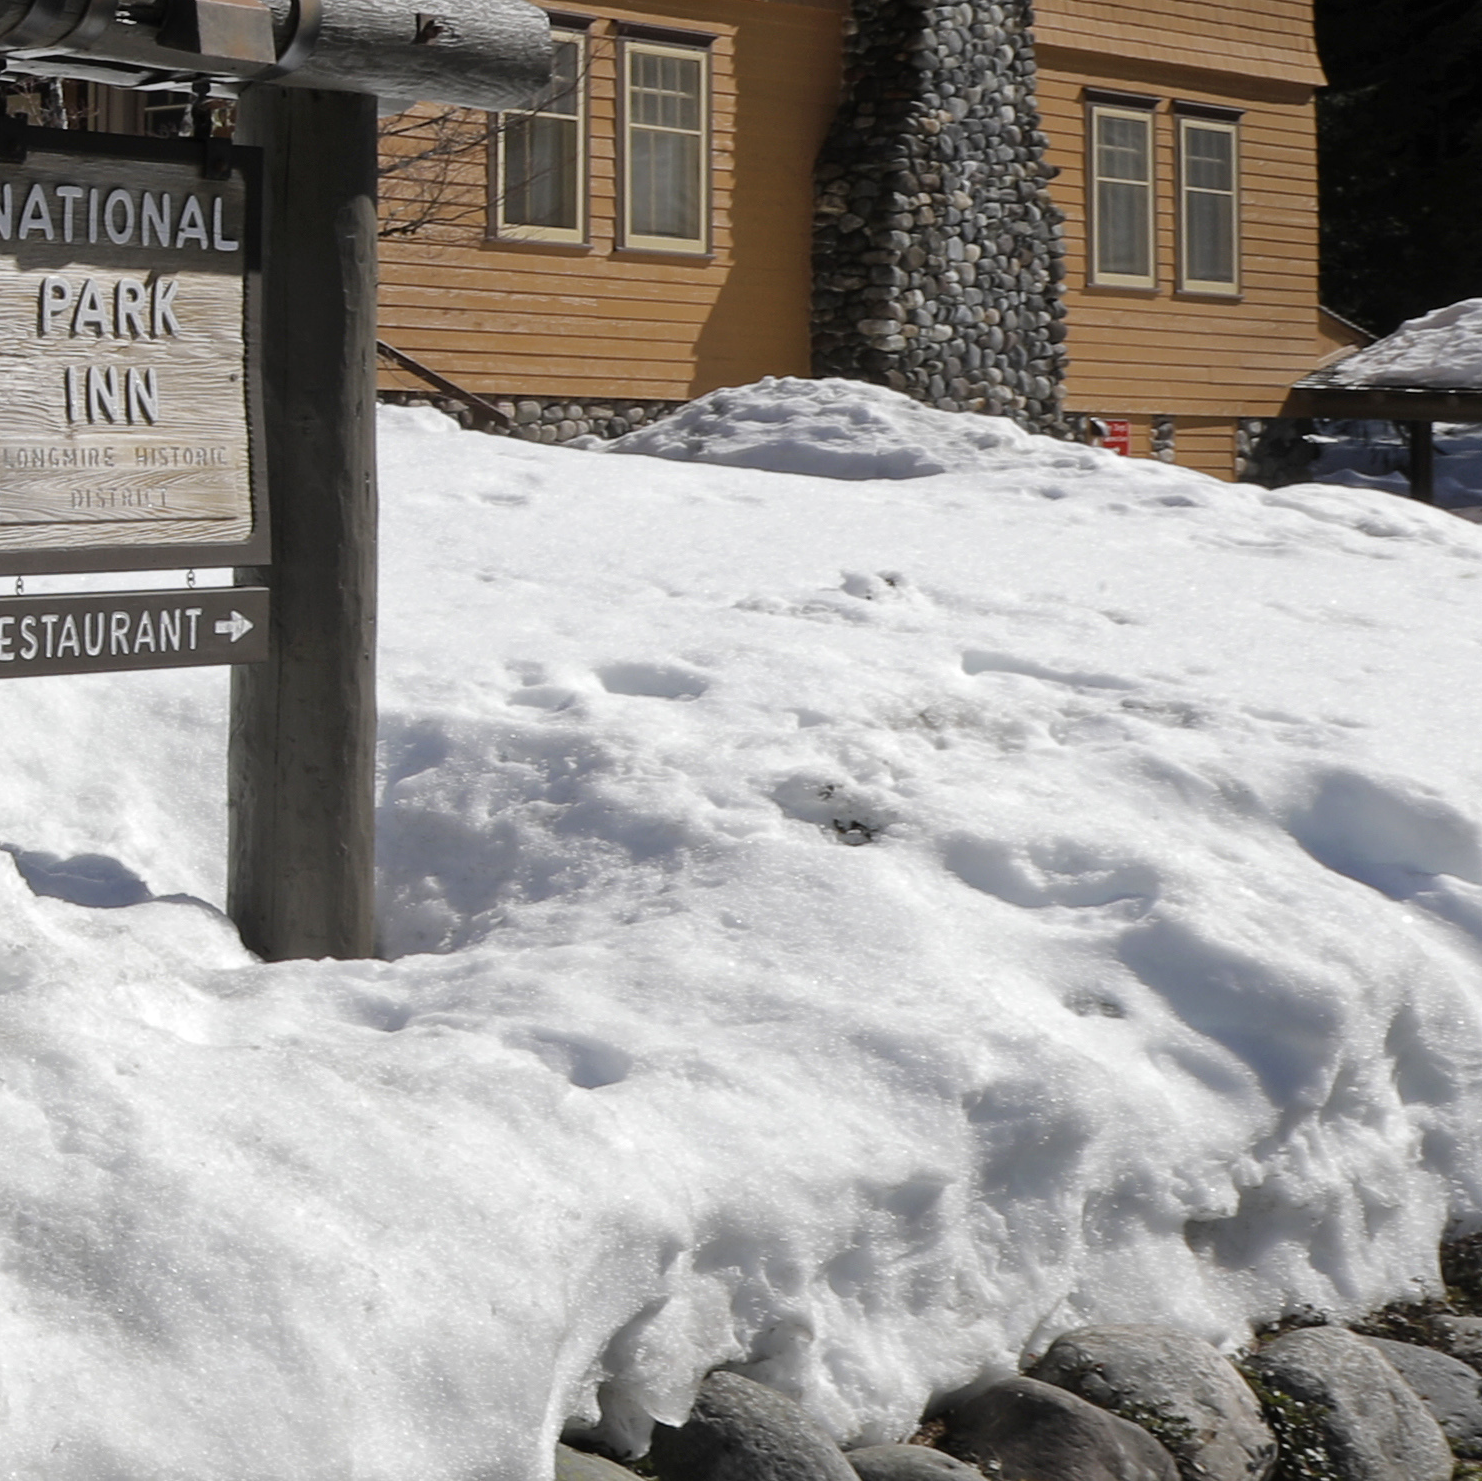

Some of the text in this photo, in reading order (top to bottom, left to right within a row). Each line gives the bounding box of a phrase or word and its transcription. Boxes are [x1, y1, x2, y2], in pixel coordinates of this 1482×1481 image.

[38, 276, 181, 339] PARK
[65, 365, 160, 424] INN
[3, 446, 228, 467] LONGMIRE HISTORIC
[71, 487, 168, 509] DISTRICT
